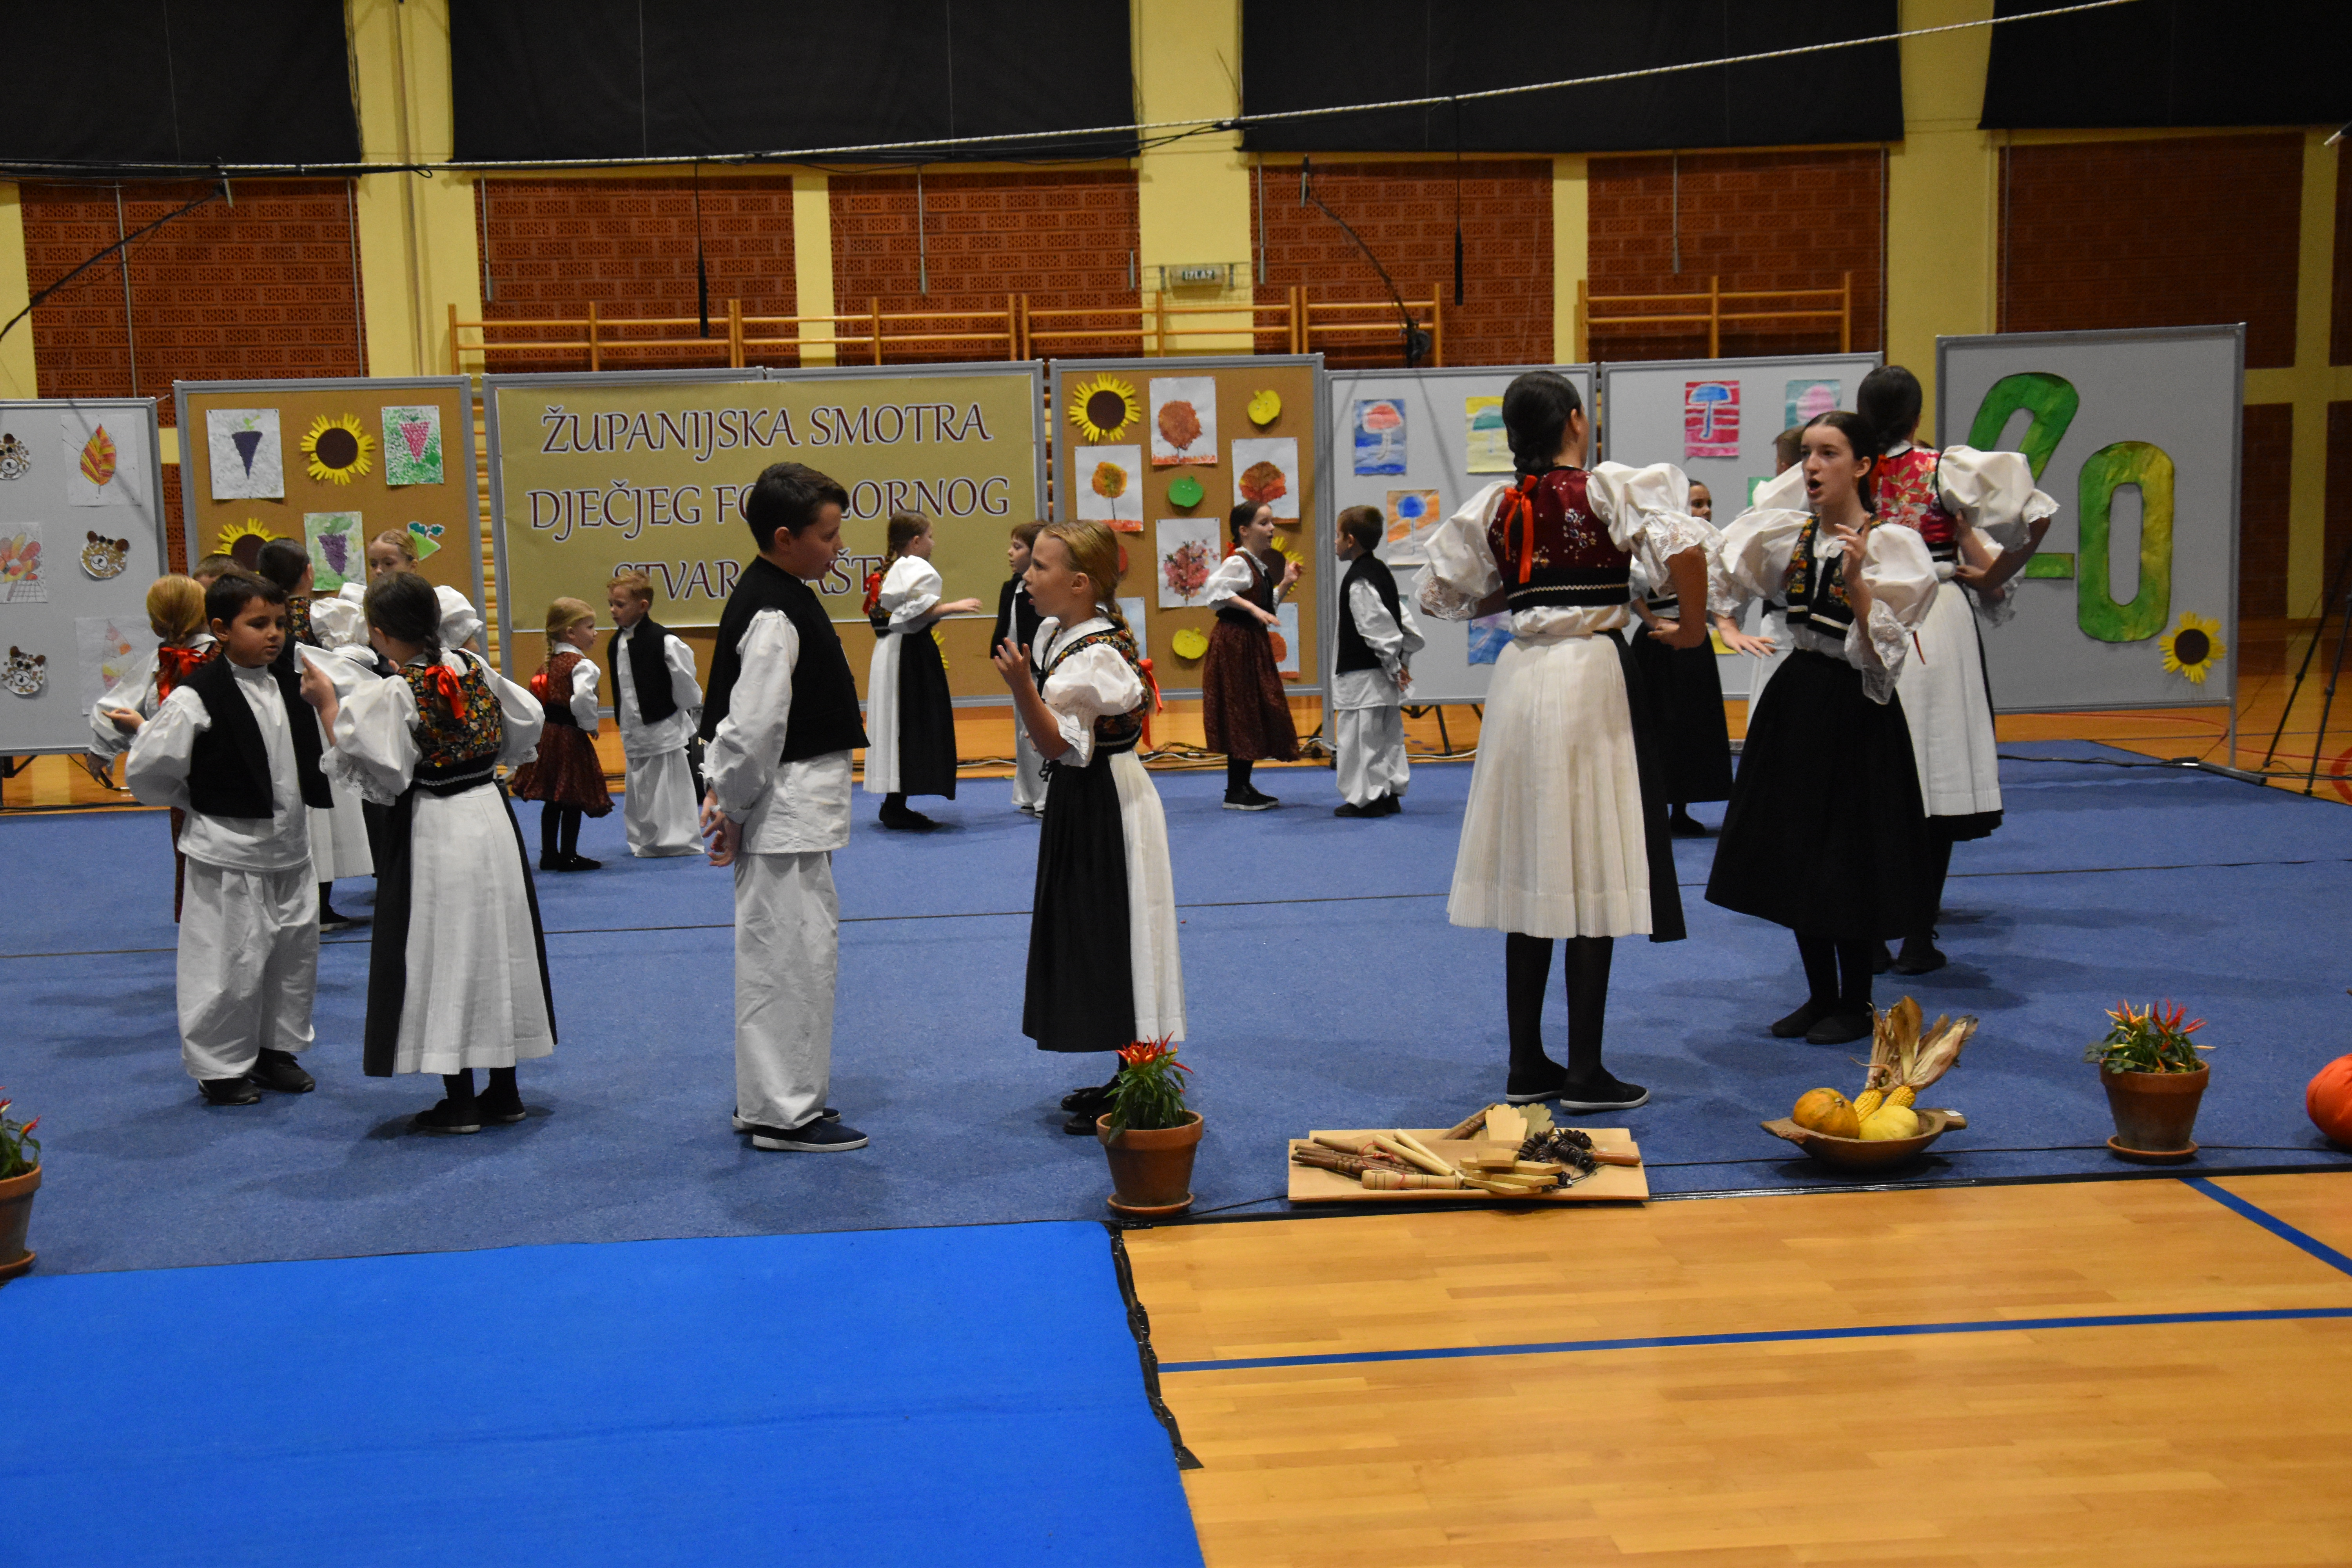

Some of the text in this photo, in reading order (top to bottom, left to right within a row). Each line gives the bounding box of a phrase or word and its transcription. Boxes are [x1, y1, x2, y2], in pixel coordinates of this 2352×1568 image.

[542, 404, 991, 462] ŽUPANIJSKA SMOTRA
[526, 477, 1009, 542] DJEČJEG FORNOG
